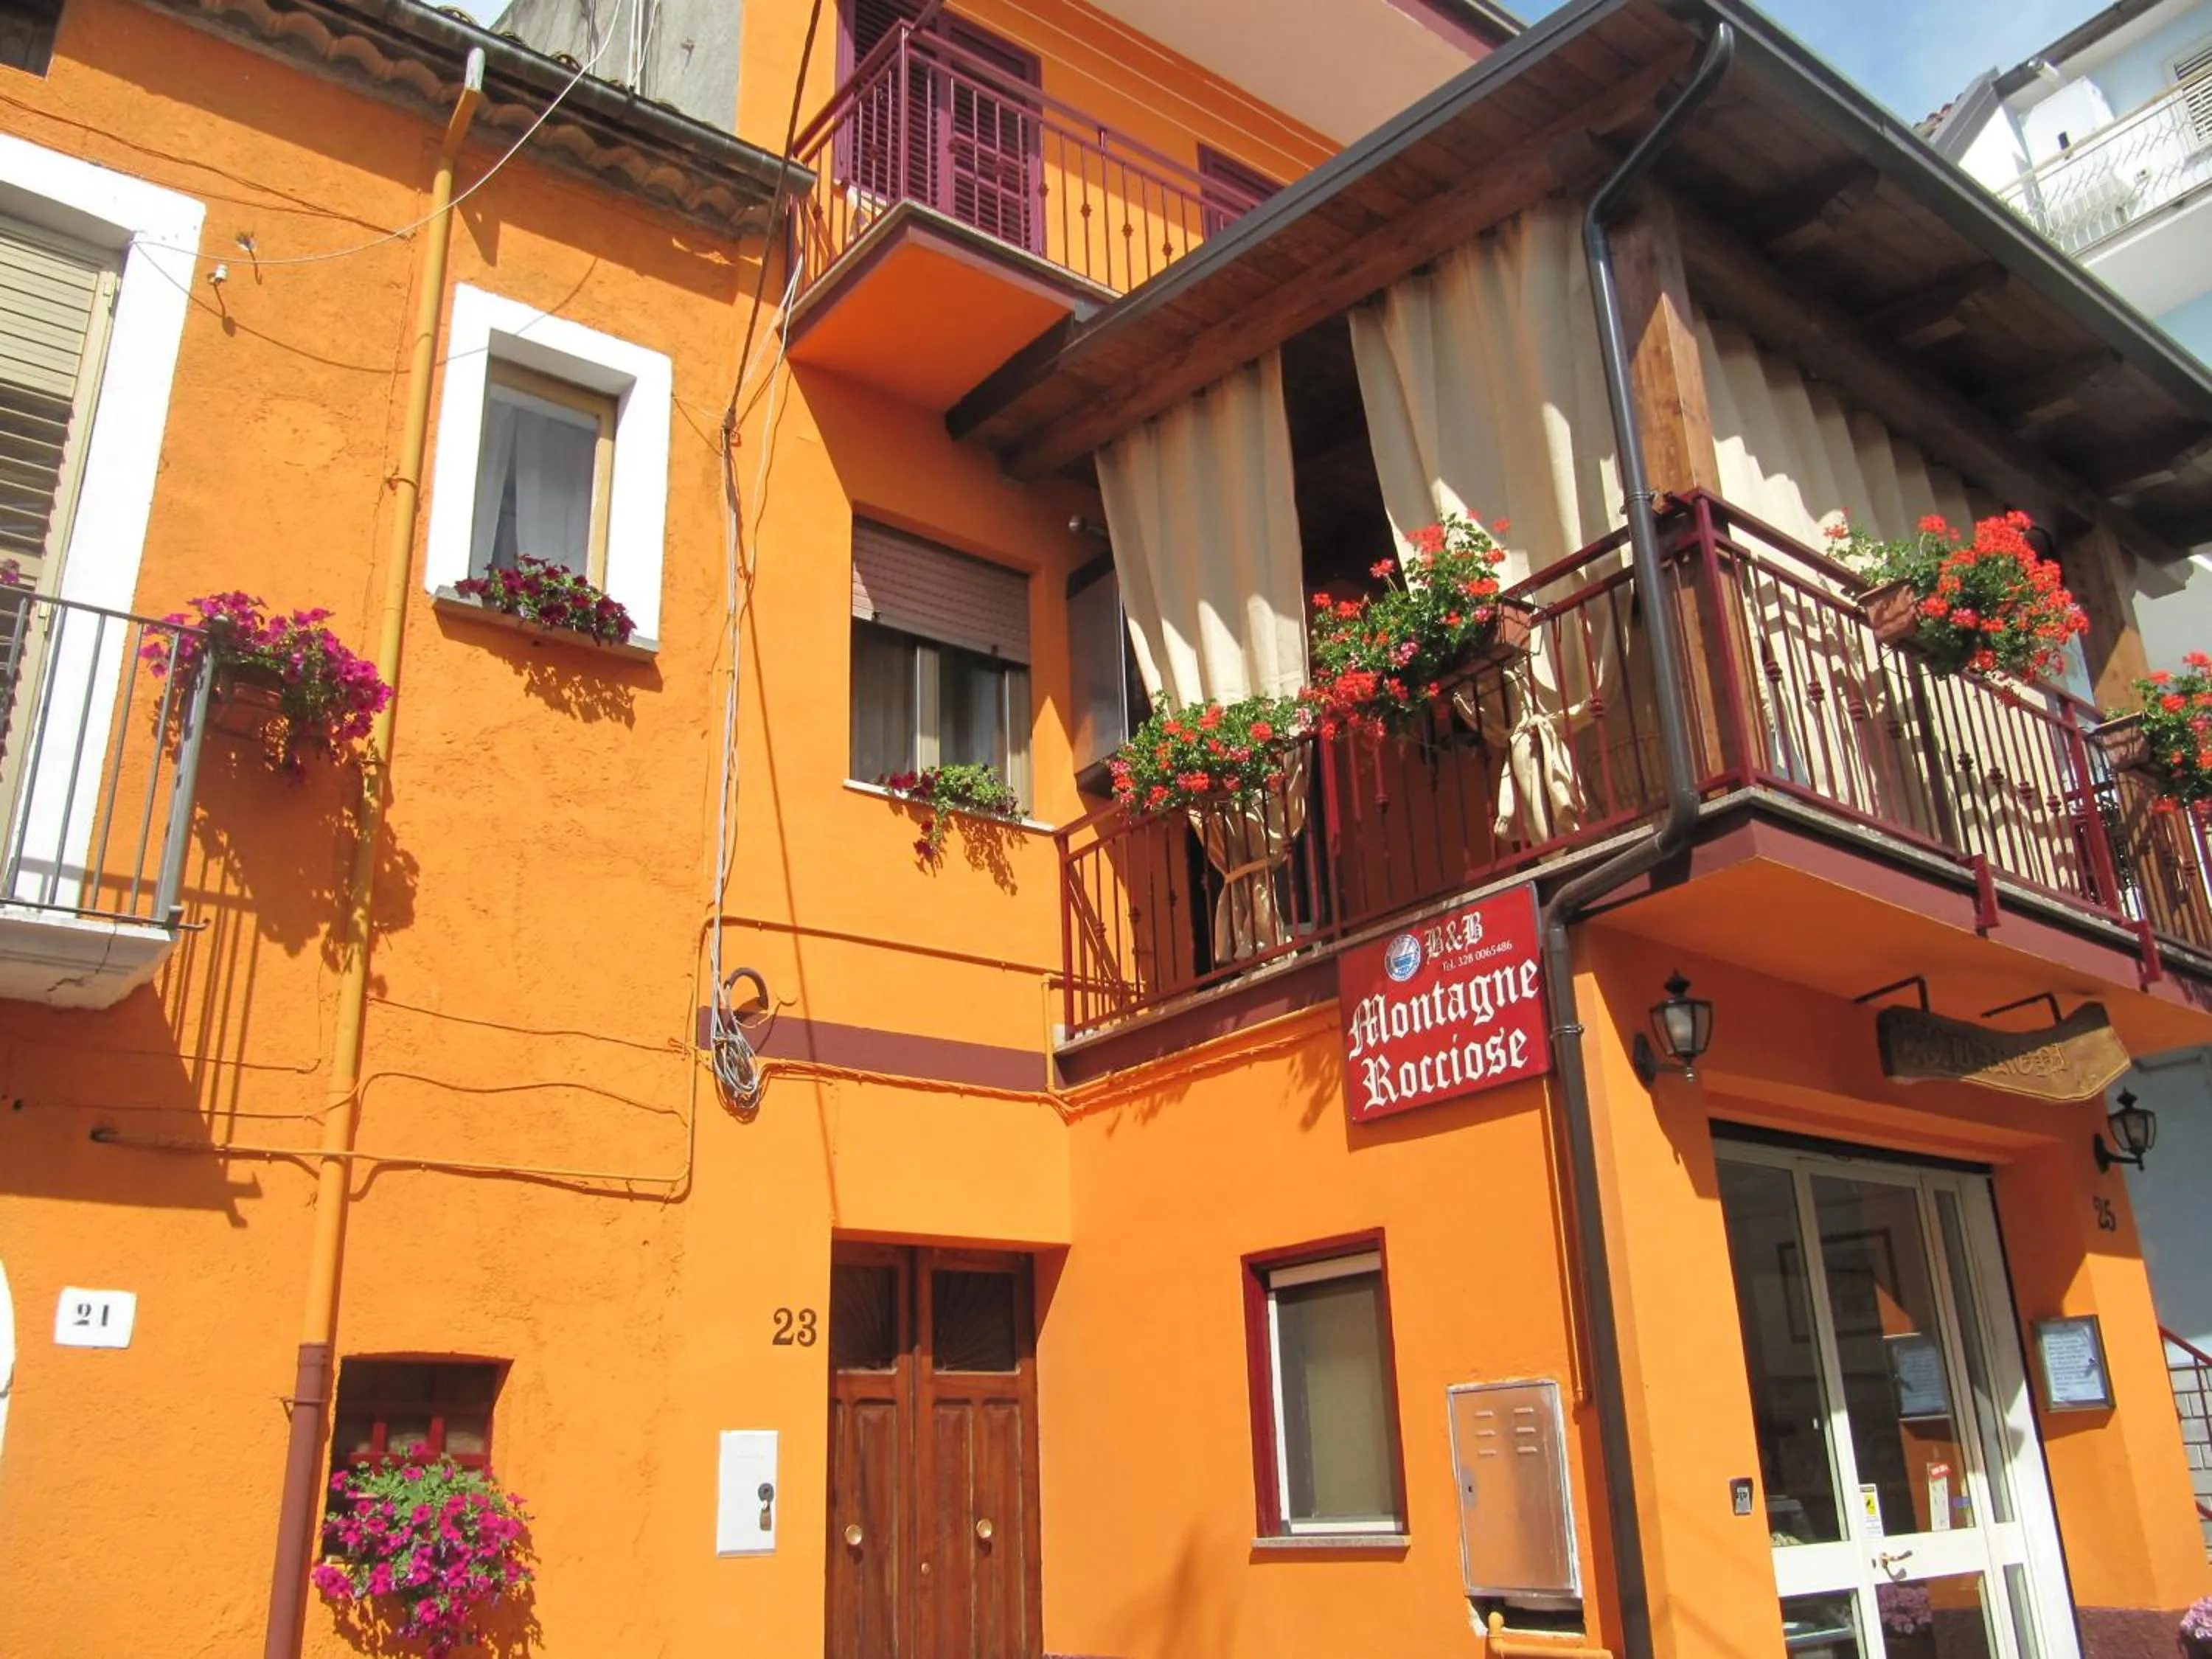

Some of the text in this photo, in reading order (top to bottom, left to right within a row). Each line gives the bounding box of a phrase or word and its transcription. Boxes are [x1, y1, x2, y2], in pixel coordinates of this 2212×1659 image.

[1425, 911, 1483, 964] B&B
[1348, 959, 1539, 1060] Montagne
[1360, 1027, 1527, 1110] Rocciose
[73, 1303, 110, 1326] 21
[772, 1307, 817, 1347] 23
